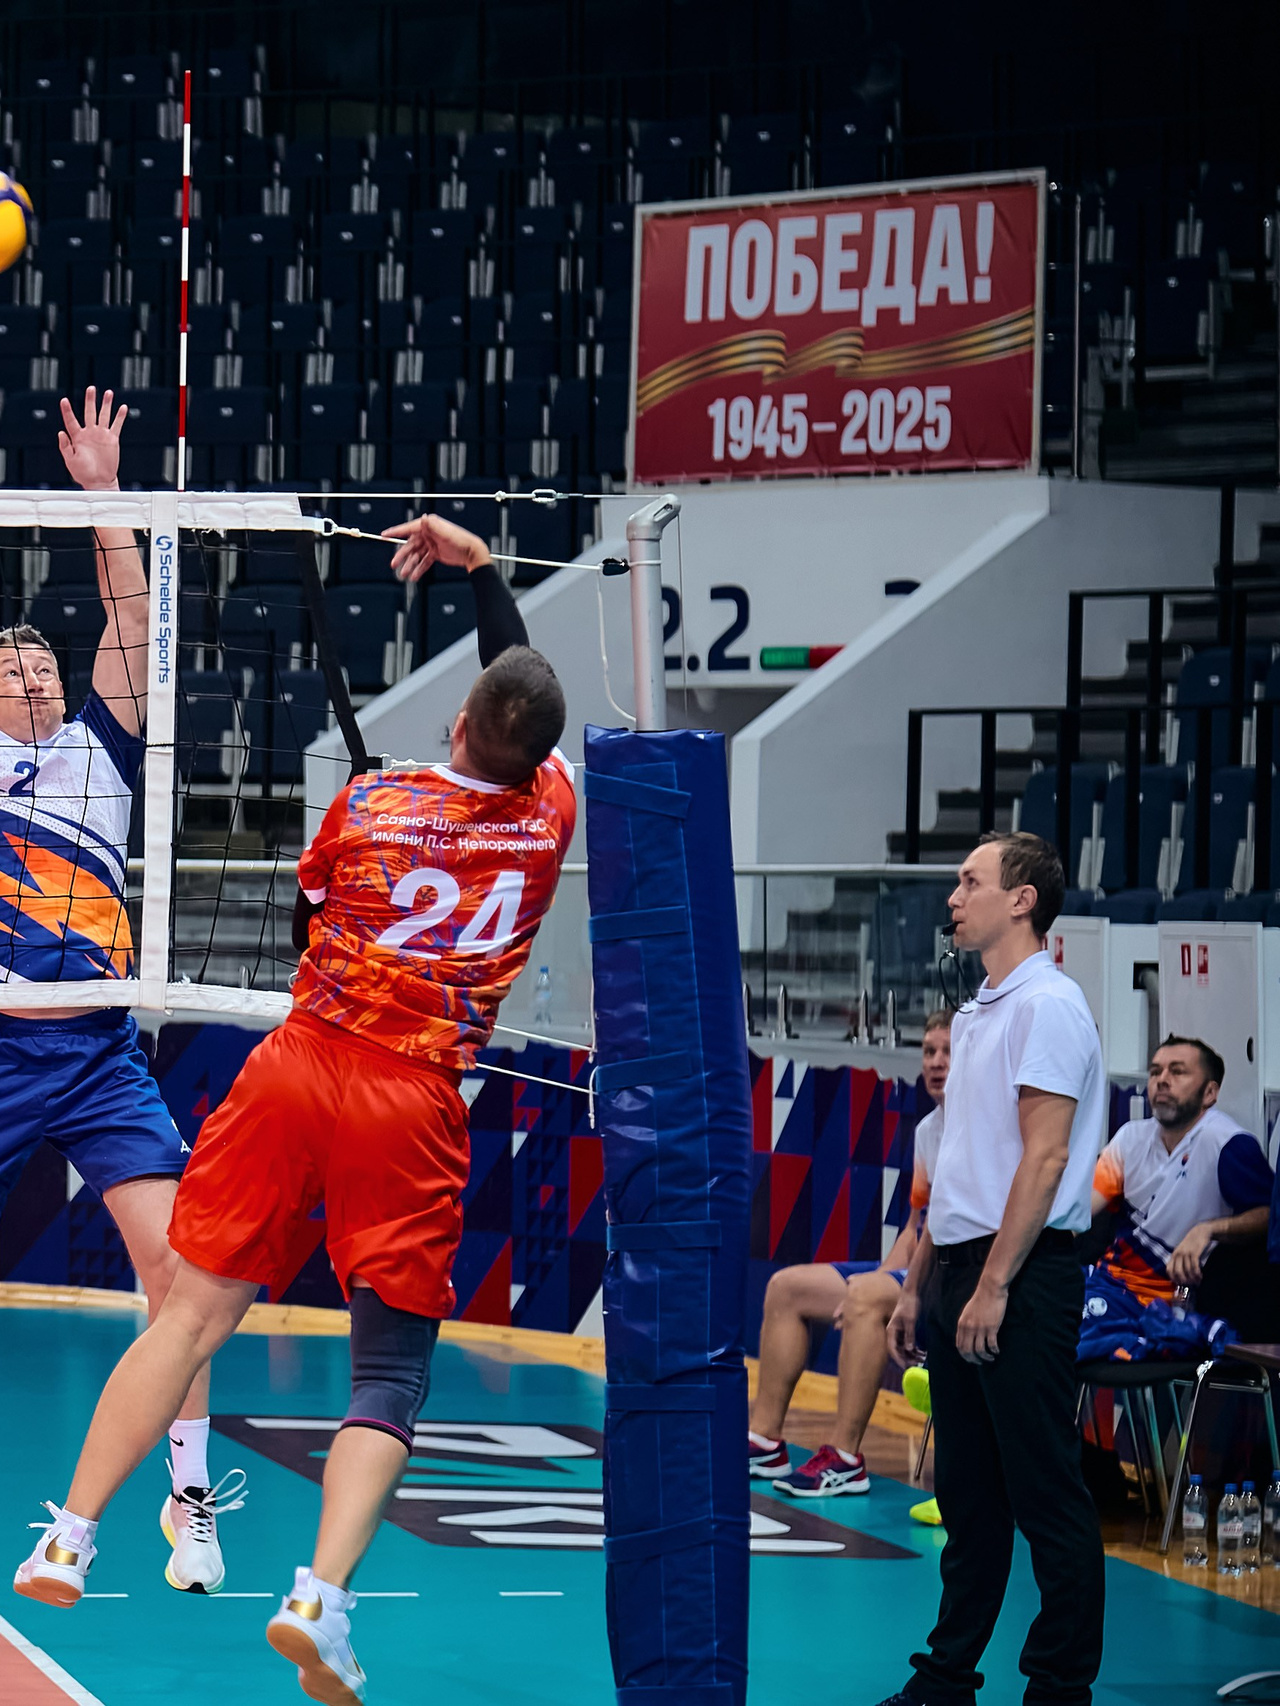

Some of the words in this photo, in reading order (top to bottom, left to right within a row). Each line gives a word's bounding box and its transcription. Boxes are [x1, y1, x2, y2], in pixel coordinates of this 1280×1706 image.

[684, 200, 996, 328] ПОБЕДА!
[158, 554, 172, 623] Schelde
[155, 627, 172, 684] Sports
[8, 760, 40, 797] 2
[372, 831, 423, 847] имени
[426, 834, 456, 850] П.С.
[458, 837, 556, 853] Непорожнего
[376, 813, 518, 834] Саяно-Шушенская
[521, 818, 547, 833] ГЭС
[375, 867, 525, 961] 24
